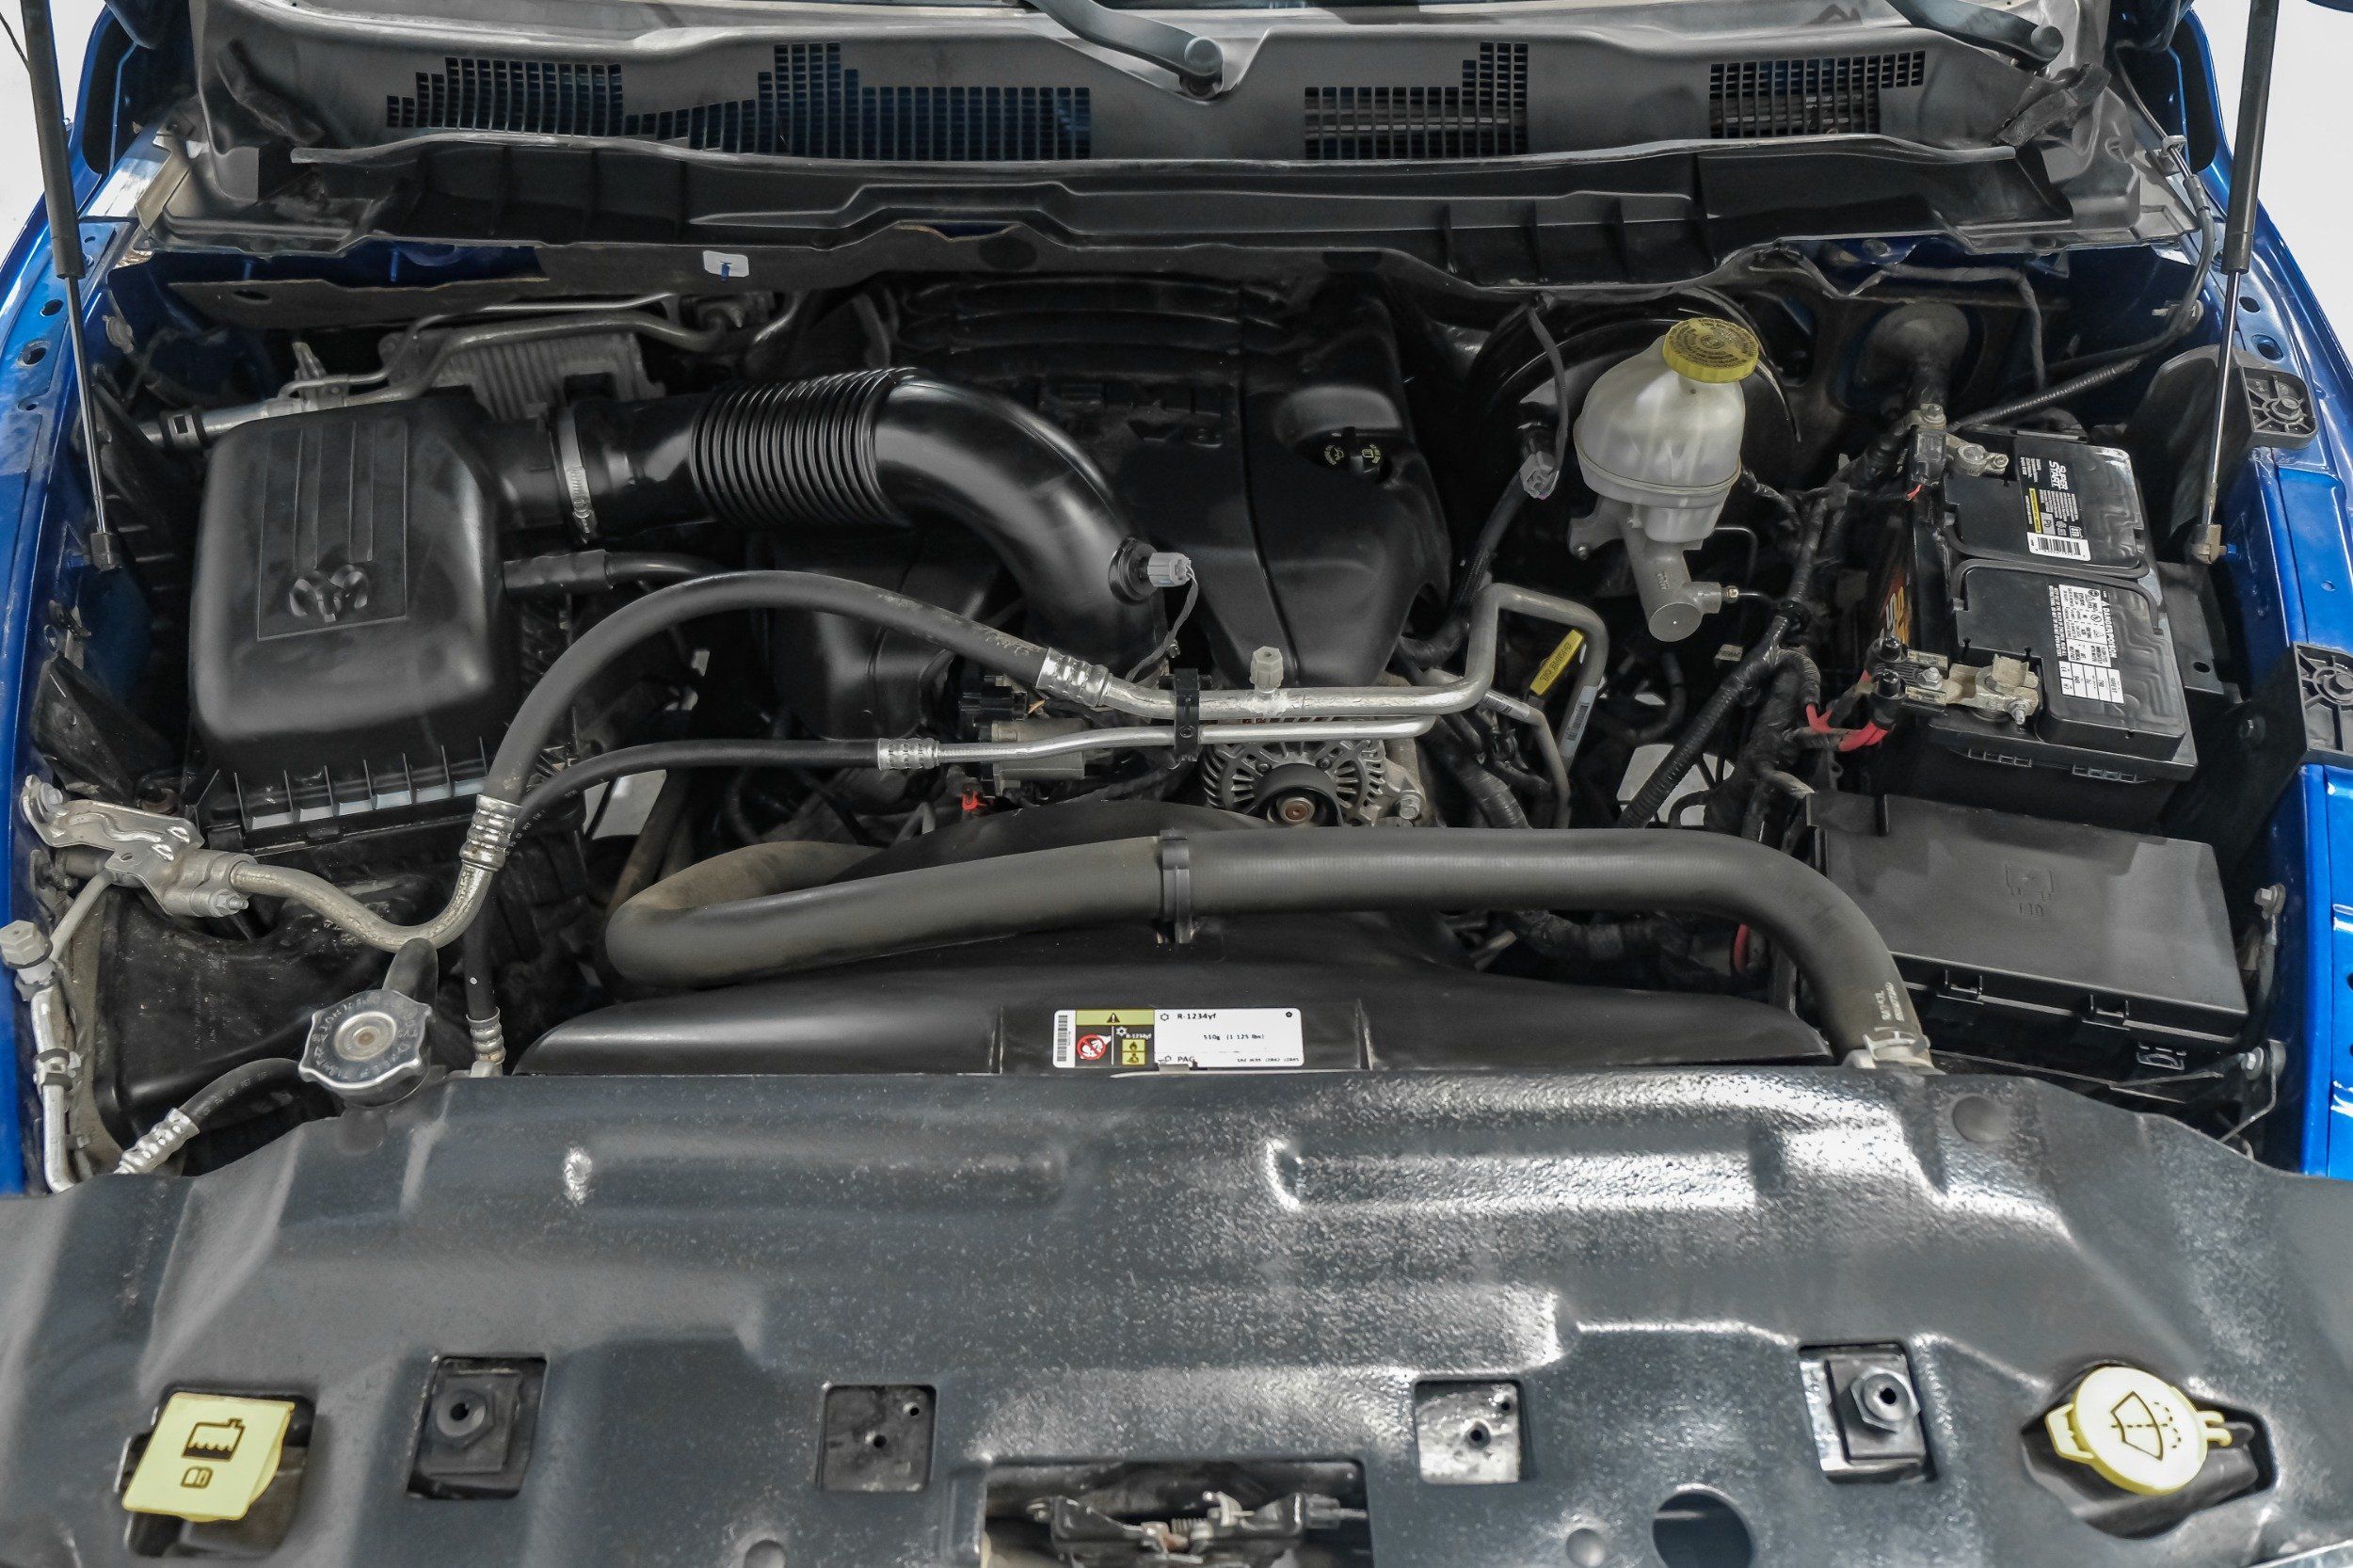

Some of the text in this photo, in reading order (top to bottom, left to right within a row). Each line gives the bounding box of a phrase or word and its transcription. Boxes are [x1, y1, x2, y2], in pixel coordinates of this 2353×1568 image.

[2049, 460, 2062, 491] START
[2058, 465, 2069, 490] SUPER
[1540, 669, 1552, 682] OIL
